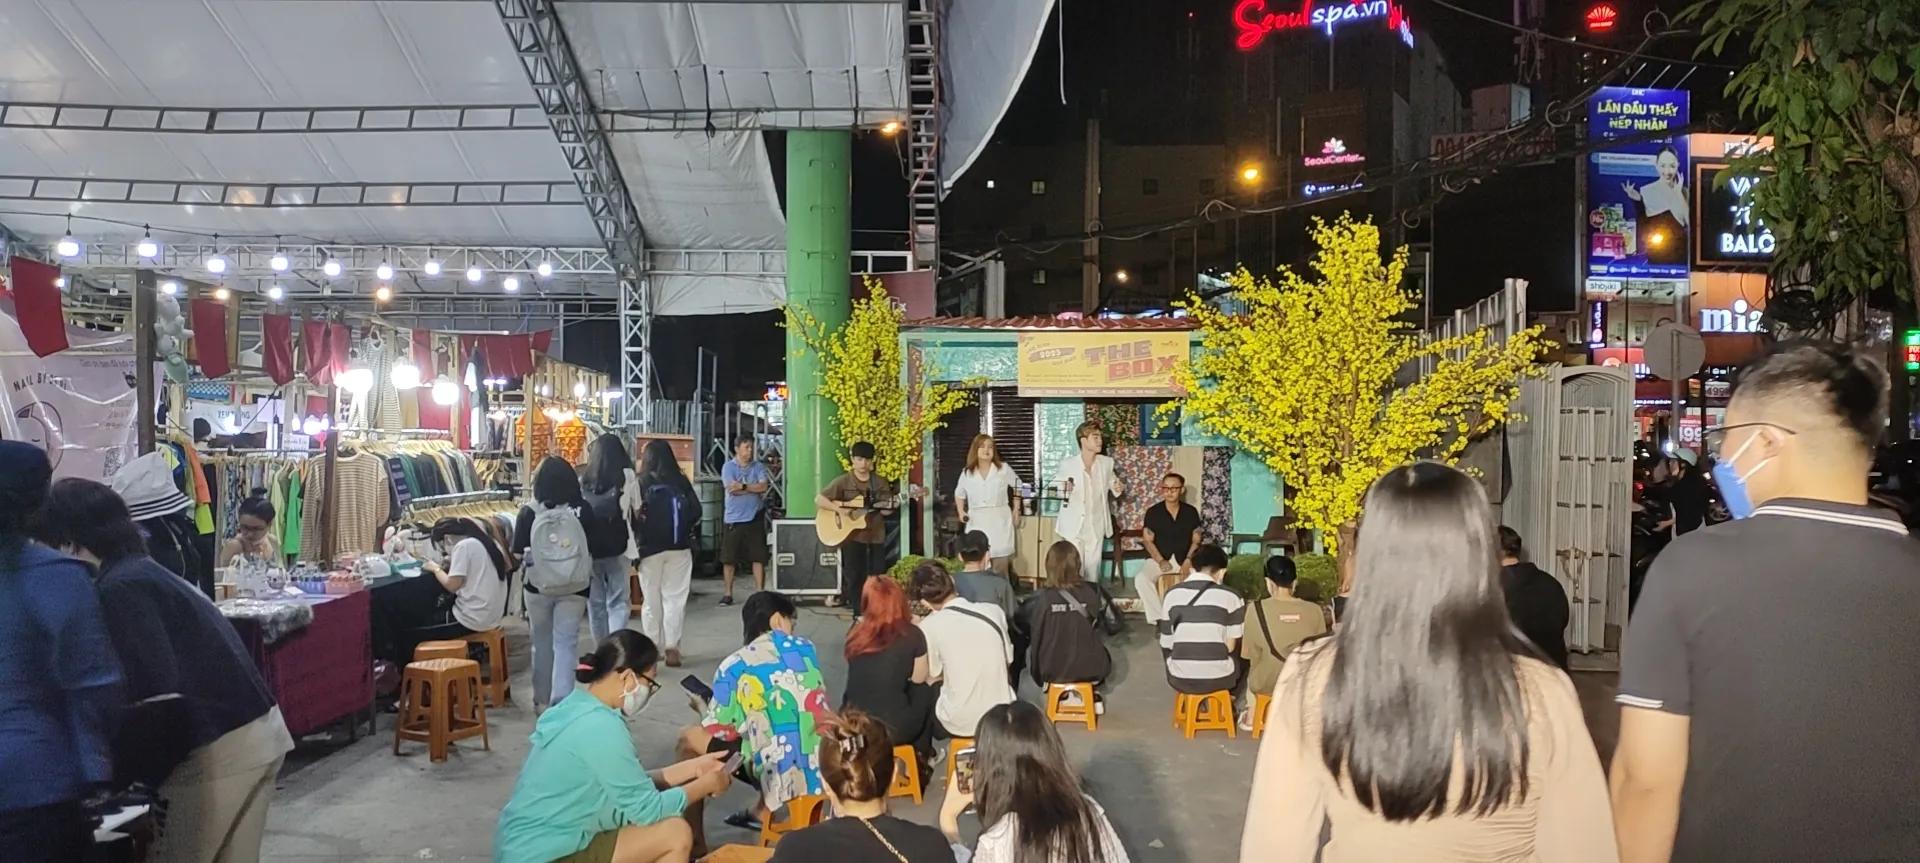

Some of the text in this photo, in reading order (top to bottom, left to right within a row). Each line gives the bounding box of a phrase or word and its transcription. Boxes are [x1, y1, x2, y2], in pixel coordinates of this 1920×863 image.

[1721, 228, 1776, 254] BALÔ
[1084, 340, 1153, 368] THE
[1107, 354, 1179, 381] BOX
[13, 374, 34, 393] NAIL
